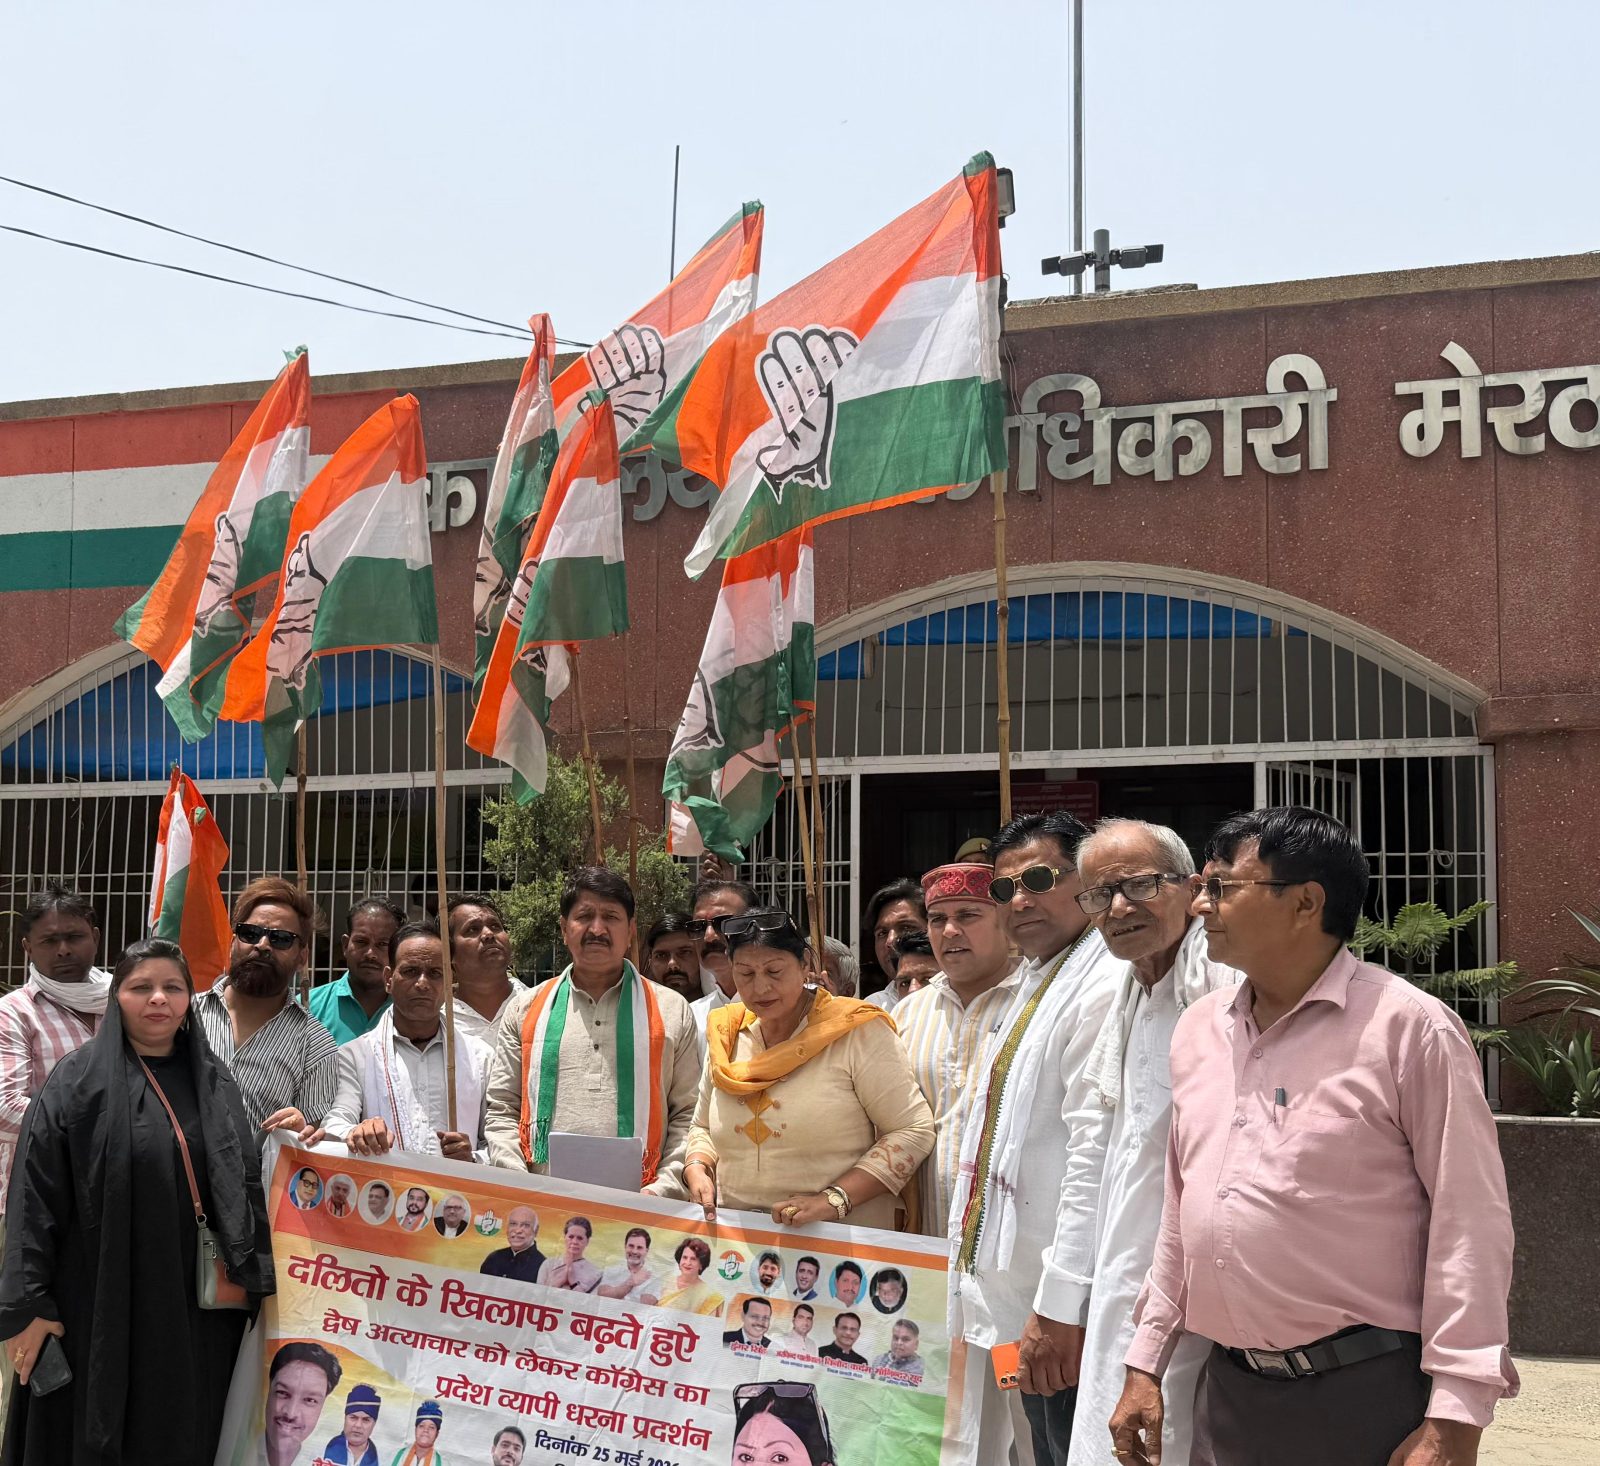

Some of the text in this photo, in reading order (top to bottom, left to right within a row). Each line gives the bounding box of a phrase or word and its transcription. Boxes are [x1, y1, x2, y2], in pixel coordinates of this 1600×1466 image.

[287, 1253, 390, 1301] दलितो
[396, 1272, 433, 1307] के
[440, 1278, 564, 1333] खिलाफ
[569, 1312, 644, 1354] बढ़ते
[322, 1307, 362, 1336] द्वेष
[365, 1322, 471, 1359] अत्याचार
[474, 1341, 511, 1367] को
[515, 1348, 582, 1380] लेकर
[673, 1381, 711, 1406] का
[434, 1373, 713, 1451] प्रदेश व्यापी धरना प्रदर्शन
[534, 1428, 591, 1457] दिनांक
[592, 1446, 610, 1463] 25
[614, 1449, 645, 1466] मई
